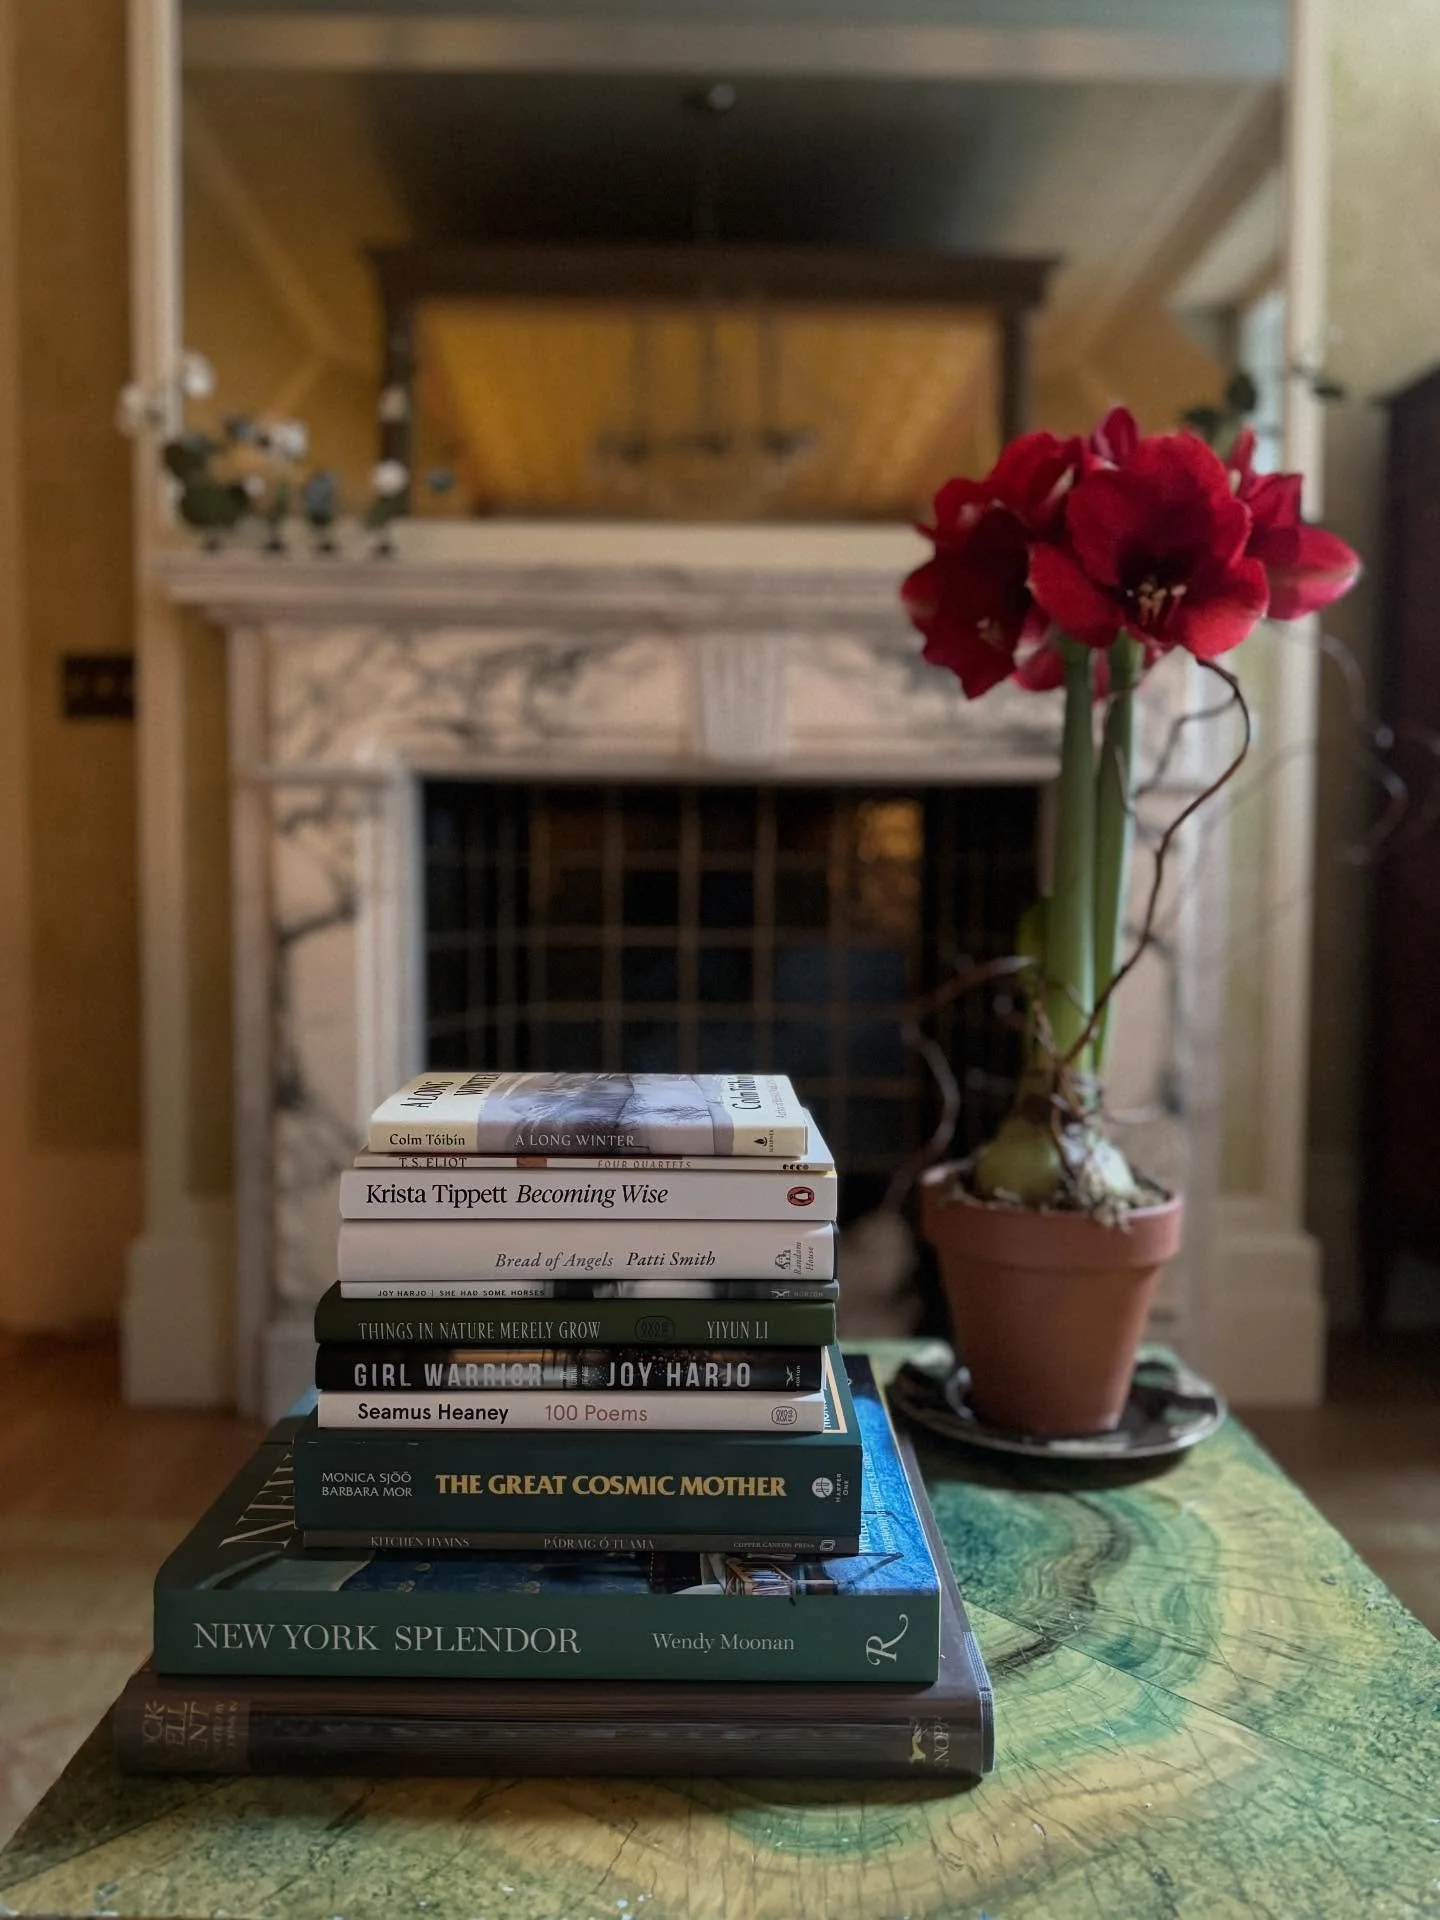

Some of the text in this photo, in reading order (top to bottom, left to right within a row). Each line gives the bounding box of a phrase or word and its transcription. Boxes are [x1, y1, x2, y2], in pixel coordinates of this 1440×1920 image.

[406, 1081, 454, 1102] LONG
[389, 1133, 465, 1146] Colm Tóibín
[515, 1134, 634, 1146] A LONG WINTER
[426, 1157, 467, 1168] ELIOT
[597, 1160, 692, 1169] FOUR QUARTETS
[366, 1184, 669, 1209] Krista Tippett Becoming Wise
[495, 1251, 716, 1271] Bread of Angels Patti Smith
[377, 1289, 545, 1297] JOY HARJO SHE HAD SOME HORSES
[358, 1321, 768, 1340] THINGS IN NATURE MERELY GROW YIYUN LI
[354, 1363, 412, 1387] GIRL
[424, 1363, 542, 1387] WARRIOR
[607, 1362, 652, 1387] JOY
[667, 1362, 751, 1388] HARJO
[357, 1403, 648, 1424] Seamus Heaney 100 Poems
[321, 1470, 412, 1485] MONICA SJÖÖ
[435, 1474, 787, 1497] THE GREAT COSMIC MOTHER
[321, 1487, 413, 1497] BARBARA MOR
[370, 1535, 470, 1547] KITCHEN HYMNS
[543, 1536, 596, 1550] PÁDRAIG
[599, 1535, 609, 1550] Ó
[193, 1622, 582, 1654] NEW YORK SPLENDOR
[652, 1632, 795, 1654] Wendy Moonan
